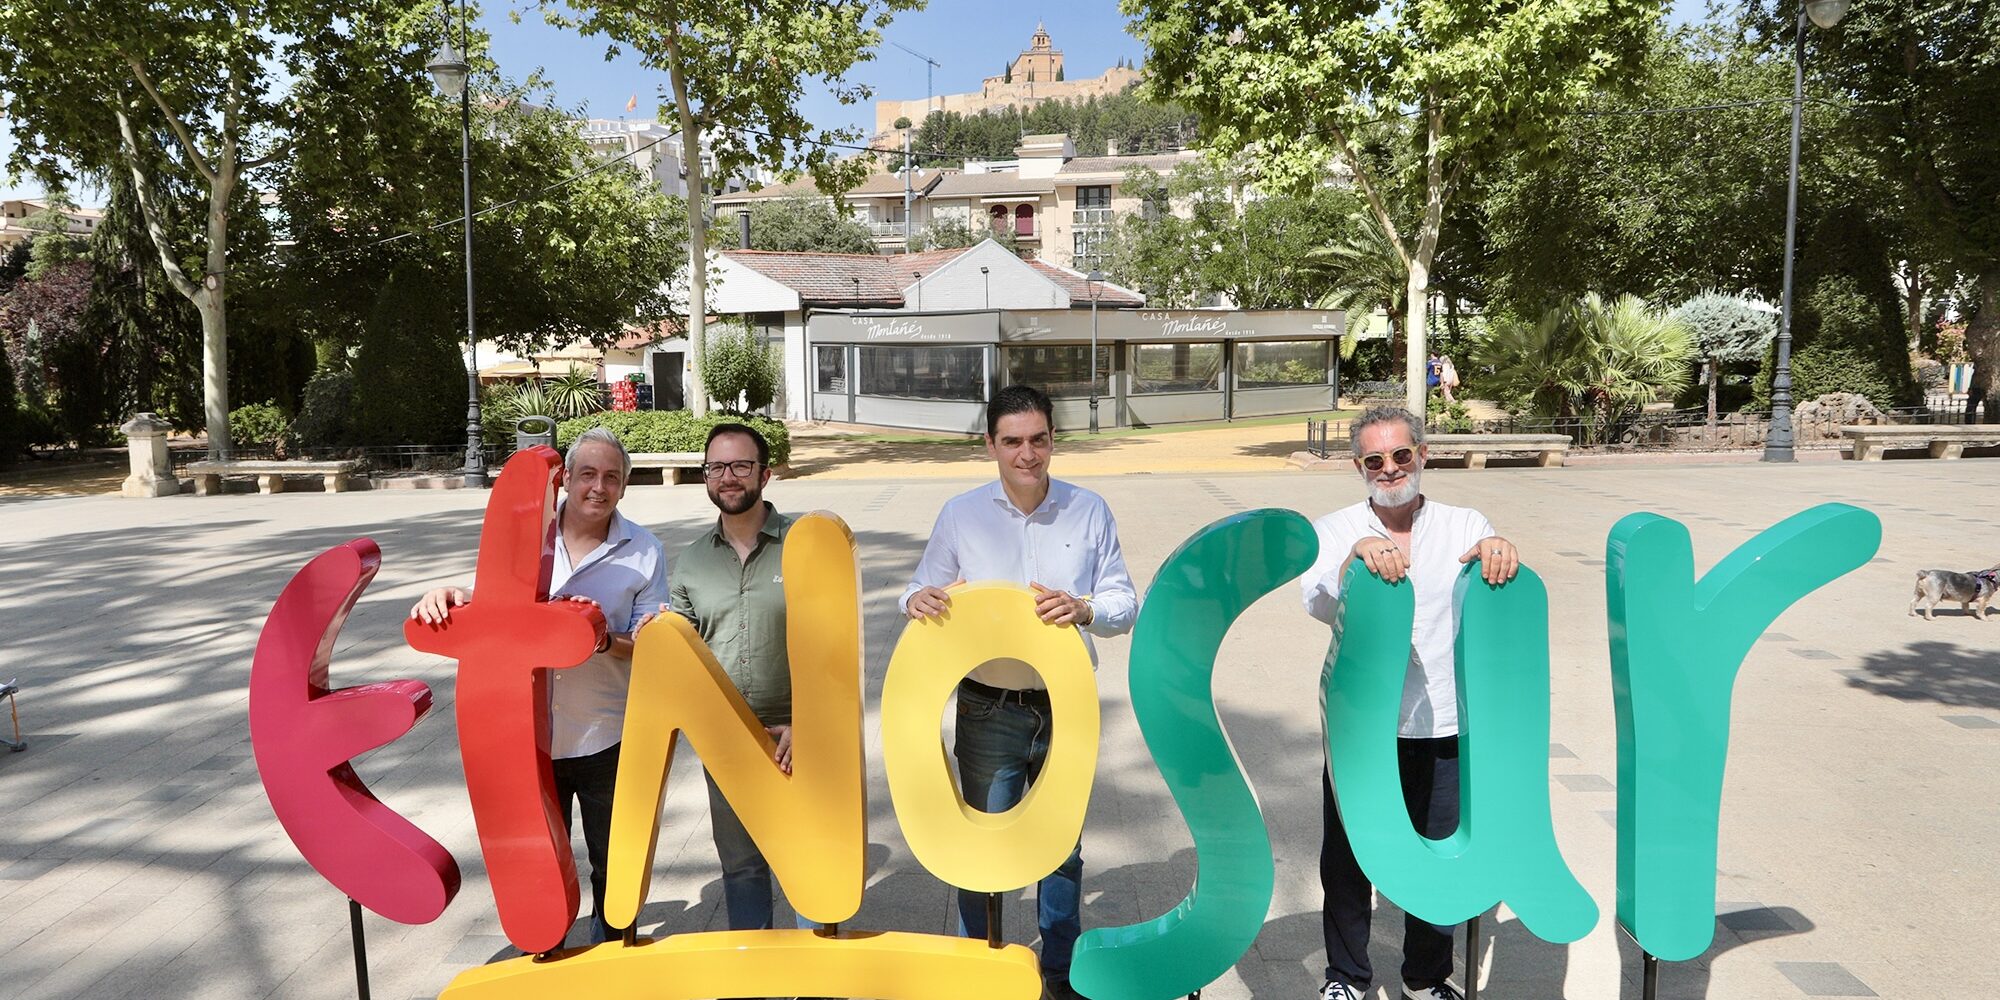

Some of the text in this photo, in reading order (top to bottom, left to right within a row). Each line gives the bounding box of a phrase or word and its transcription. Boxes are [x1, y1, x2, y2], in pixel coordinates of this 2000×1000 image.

[852, 317, 874, 325] CASA
[867, 318, 922, 339] Montañés
[1161, 314, 1227, 336] Montañés
